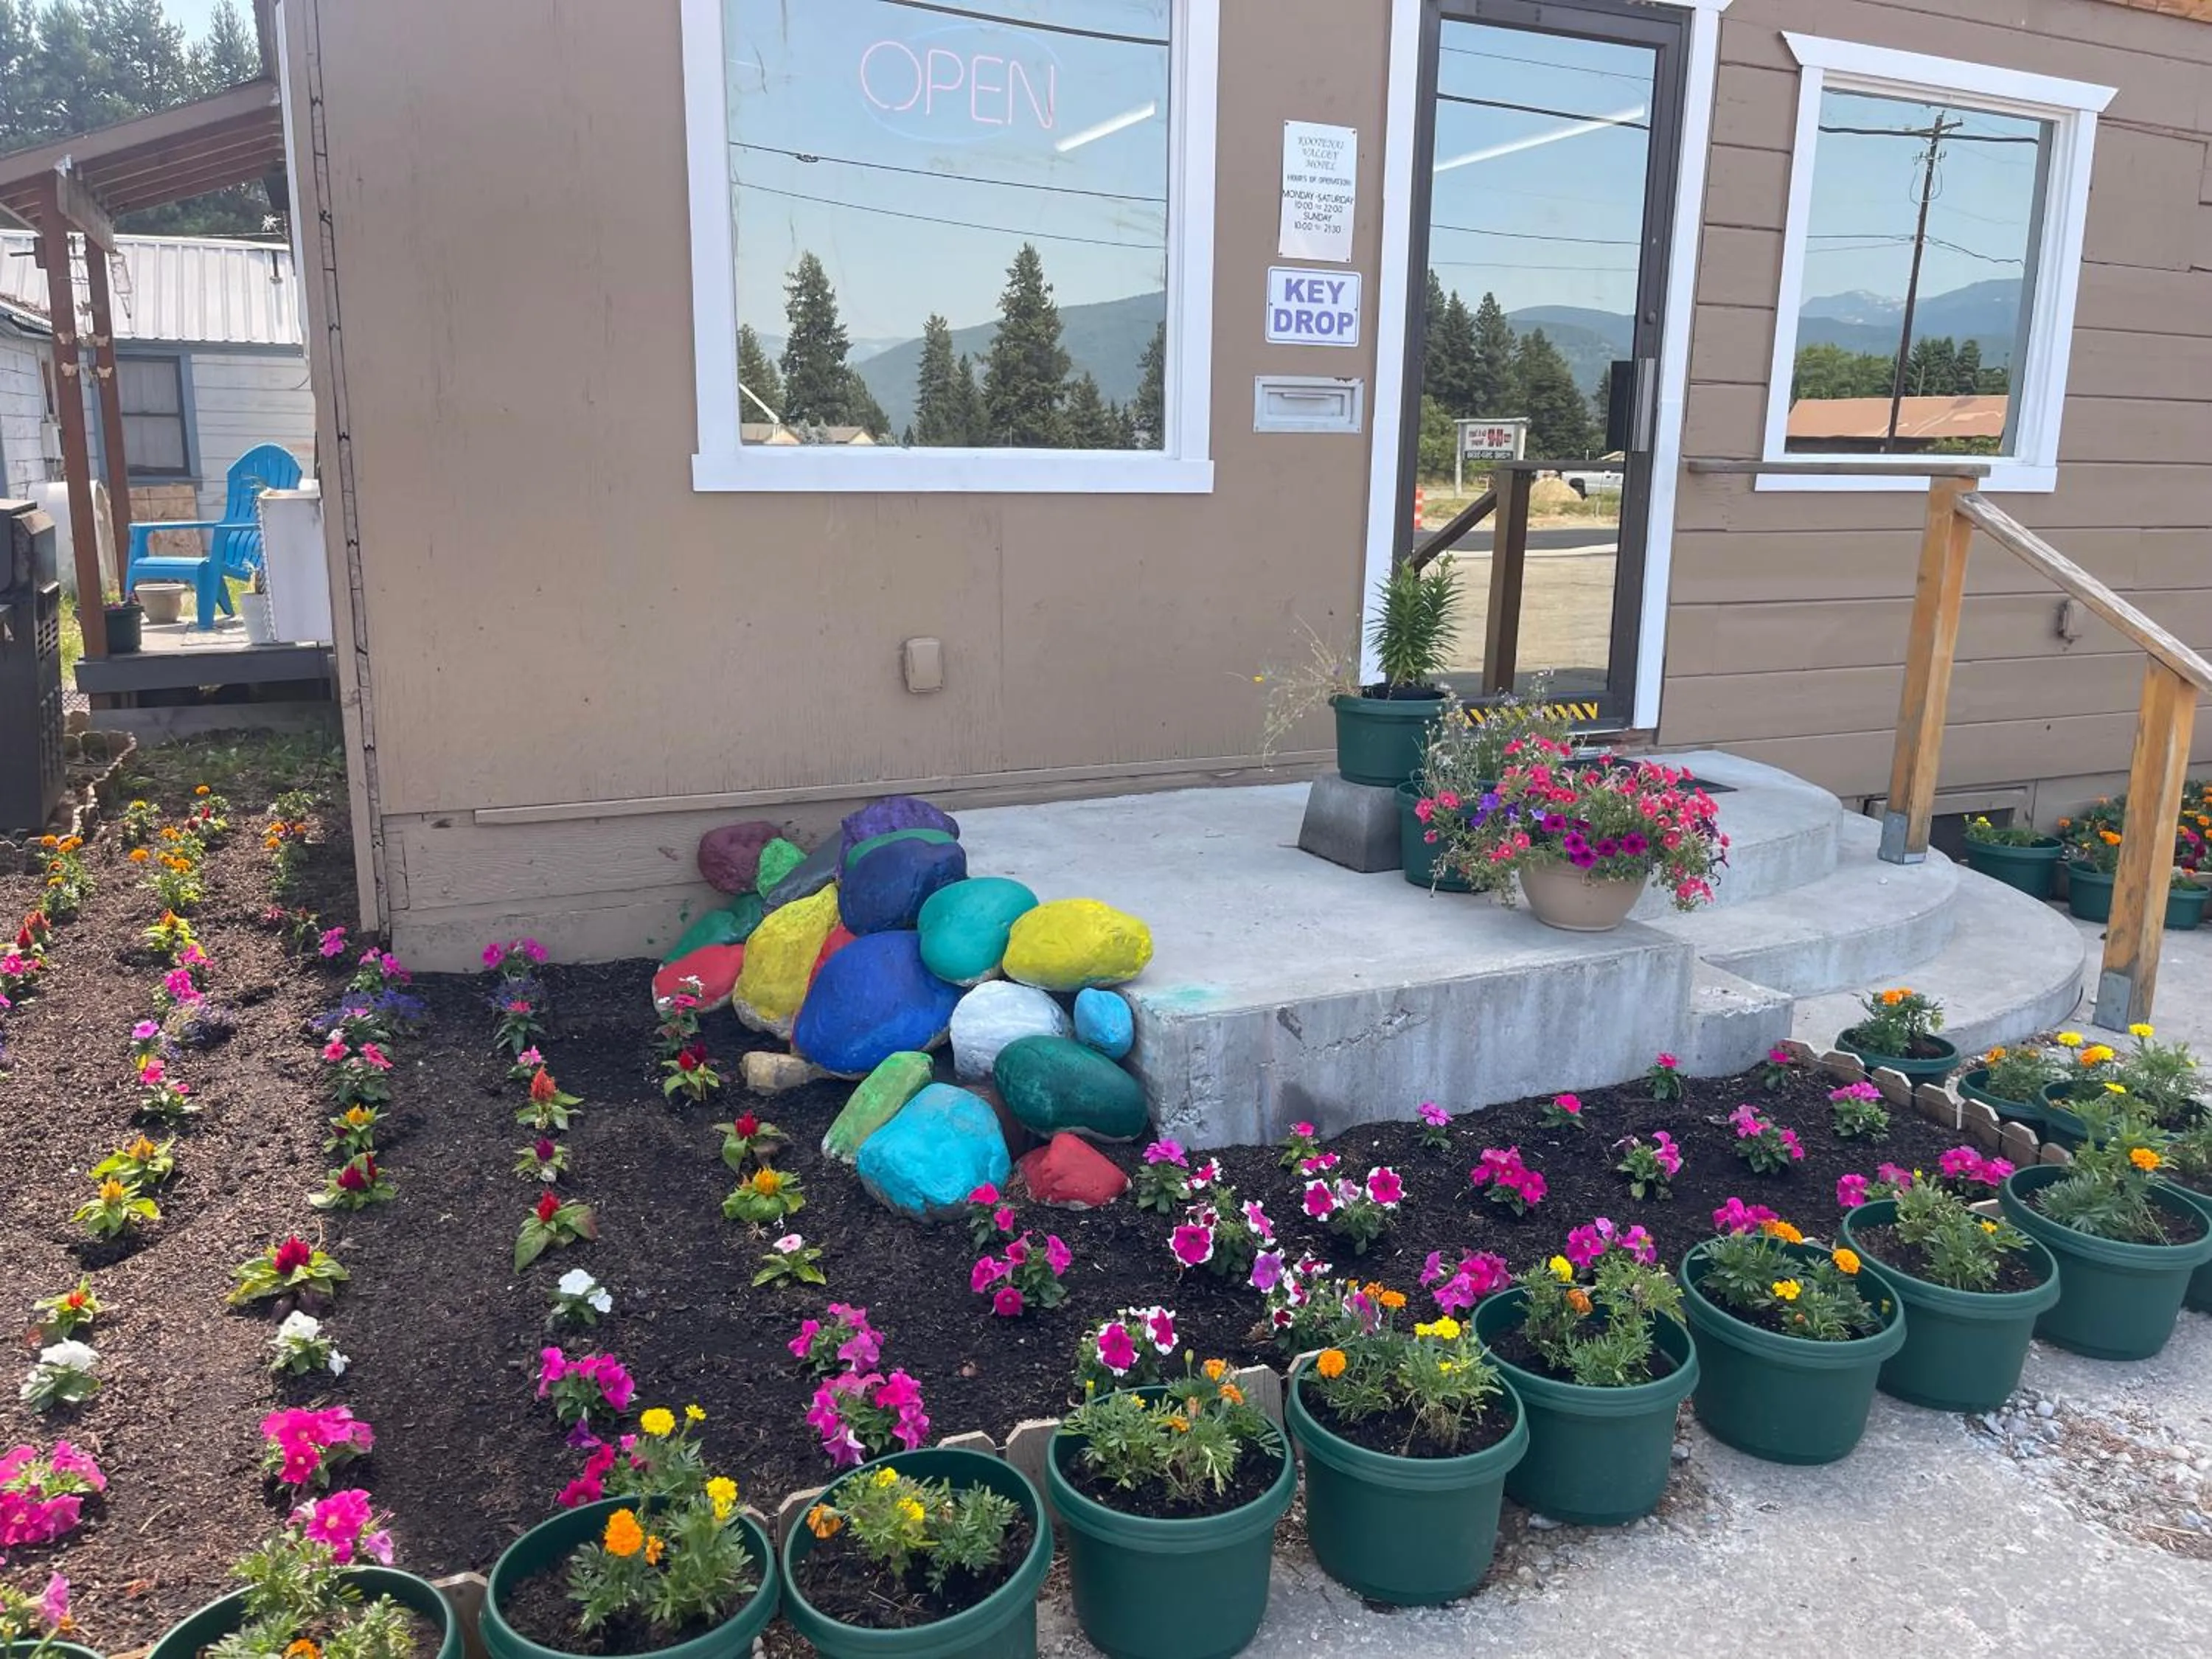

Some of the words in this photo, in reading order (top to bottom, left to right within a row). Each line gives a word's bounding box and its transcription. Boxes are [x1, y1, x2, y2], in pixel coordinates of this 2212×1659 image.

[860, 41, 1055, 128] OPEN
[1283, 189, 1313, 200] MONDAY
[1304, 212, 1332, 222] SUNDAY
[1285, 278, 1346, 305] KEY
[1273, 308, 1354, 335] DROP
